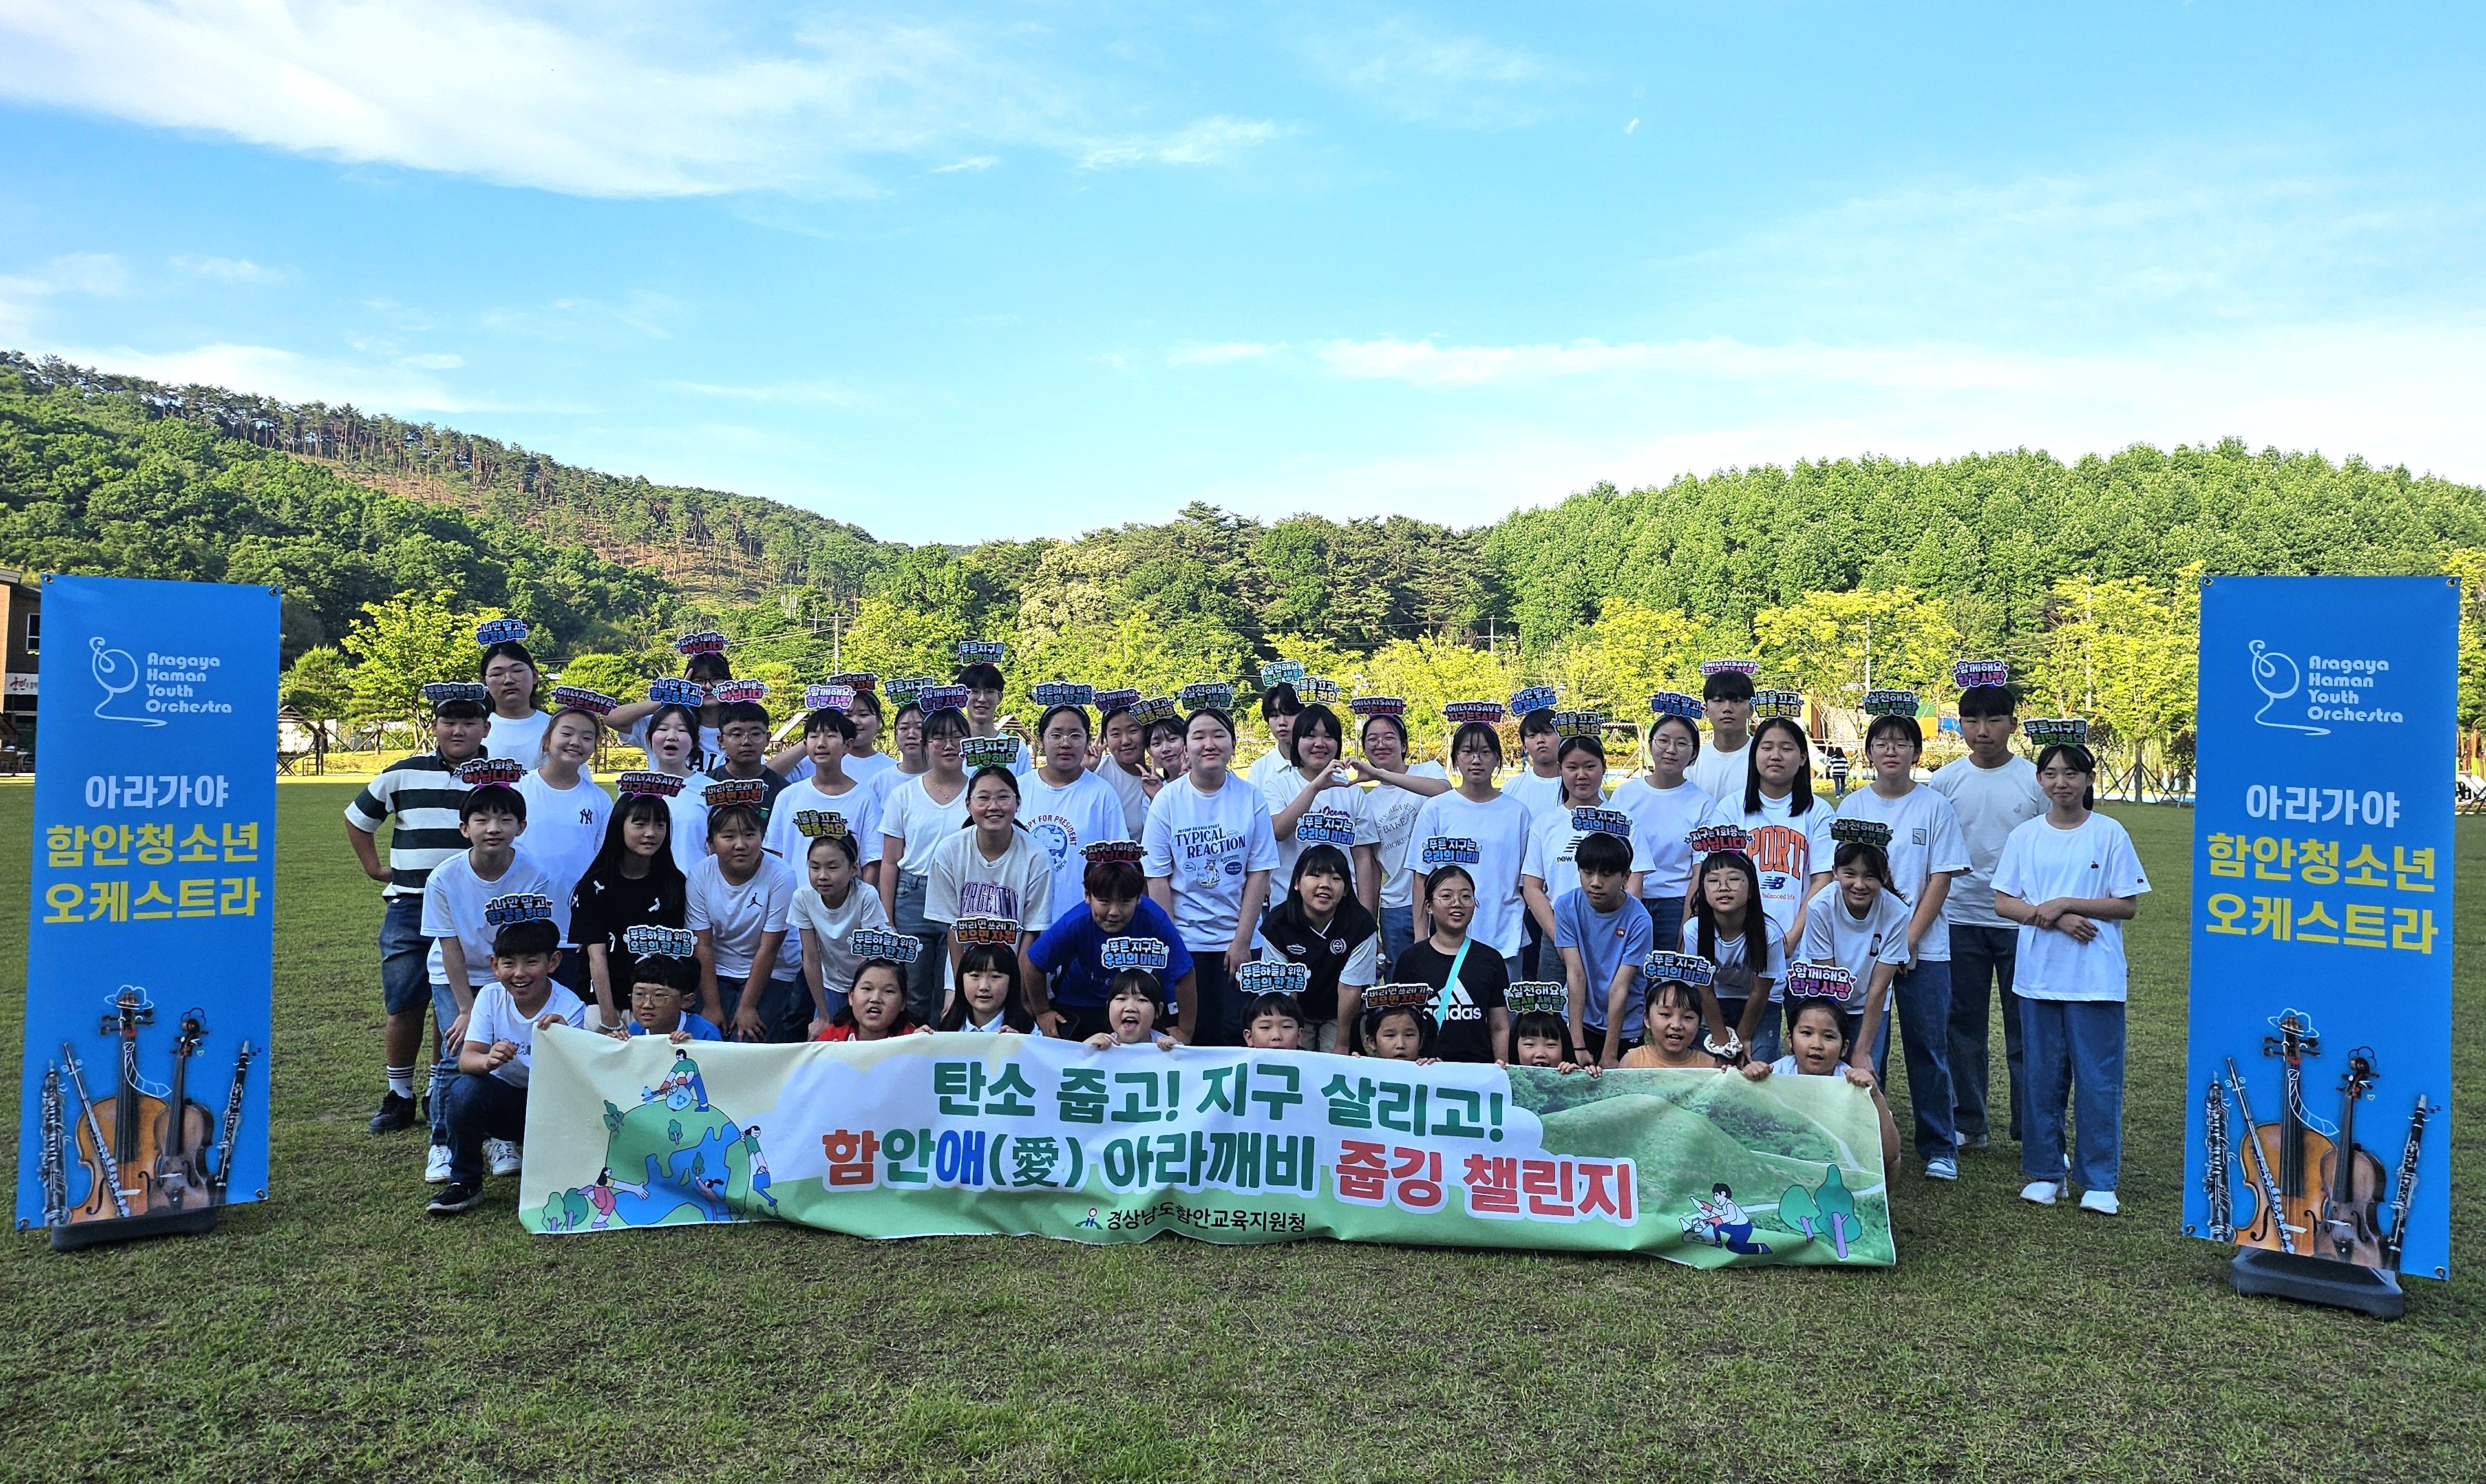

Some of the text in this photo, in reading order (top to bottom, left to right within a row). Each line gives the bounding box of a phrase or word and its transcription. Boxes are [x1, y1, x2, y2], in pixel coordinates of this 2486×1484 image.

[147, 653, 220, 670] Aragaya
[1959, 662, 2002, 673] 함께해요
[2309, 655, 2388, 674] Aragaya
[147, 668, 206, 681] Haman
[2309, 673, 2374, 687] Haman
[145, 684, 193, 697] Youth
[659, 679, 699, 695] 나만 말고
[810, 687, 851, 696] 함께해요
[1301, 679, 1317, 690] 불을
[719, 689, 762, 700] 아닙니다
[924, 688, 965, 698] 함께해요
[1515, 688, 1551, 701] 나만 말고
[1758, 692, 1798, 703] 불을 끄고
[2308, 690, 2359, 704] Youth
[145, 699, 231, 713] Orchestra
[1448, 704, 1500, 712] 에너지SAVE
[1758, 704, 1777, 716] 별을
[1558, 714, 1597, 723] 불을 끄고
[2307, 706, 2403, 723] Orchestra
[968, 750, 1015, 766] 희망해요
[464, 770, 519, 783] 아닙니다
[624, 775, 681, 786] 에너지SAVE
[85, 776, 228, 809] 아라가야
[2246, 785, 2400, 828] 아라가야
[1578, 809, 1625, 823] 푸른 지구는
[1054, 816, 1077, 846] PRESIDENT
[1306, 816, 1352, 832] 푸른 지구는
[1573, 818, 1629, 834] 우리의 미래
[1174, 827, 1226, 846] TYPICAL
[1299, 827, 1354, 844] 우리의 미래
[47, 822, 258, 867] 함안청소년
[1187, 835, 1246, 858] REACTION
[1429, 840, 1476, 851] 푸른 지구는
[1694, 837, 1746, 851] 아닙니다
[1423, 849, 1478, 864] 우리의 미래
[2207, 832, 2435, 893] 함안청소년
[43, 876, 260, 923] 오케스트라
[492, 896, 545, 909] 나만 말고
[2205, 893, 2438, 954] 오케스트라
[630, 929, 690, 942] 푸른하늘을 위한
[855, 932, 916, 948] 푸른하늘을 위한
[959, 931, 1015, 942] 모으면 자원
[632, 940, 659, 951] 오늘의
[854, 944, 883, 955] 오늘의
[1110, 940, 1161, 953] 푸른 지구는
[1105, 953, 1165, 966] 우리의 미래
[1655, 955, 1673, 966] 푸른
[1677, 957, 1708, 972] 지구는
[1243, 964, 1304, 977] 푸른하늘을 위한
[1646, 964, 1710, 982] 우리의 미래
[1794, 964, 1849, 982] 함께해요
[1242, 977, 1272, 989] 오늘의
[1513, 984, 1558, 997] 실천해요
[1509, 995, 1535, 1010] 녹색
[934, 1061, 1503, 1143] 탄소 줍고! 지구 살리고!
[822, 1129, 1633, 1220] 함안애(愛) 아라깨비 줍깅 챌린지
